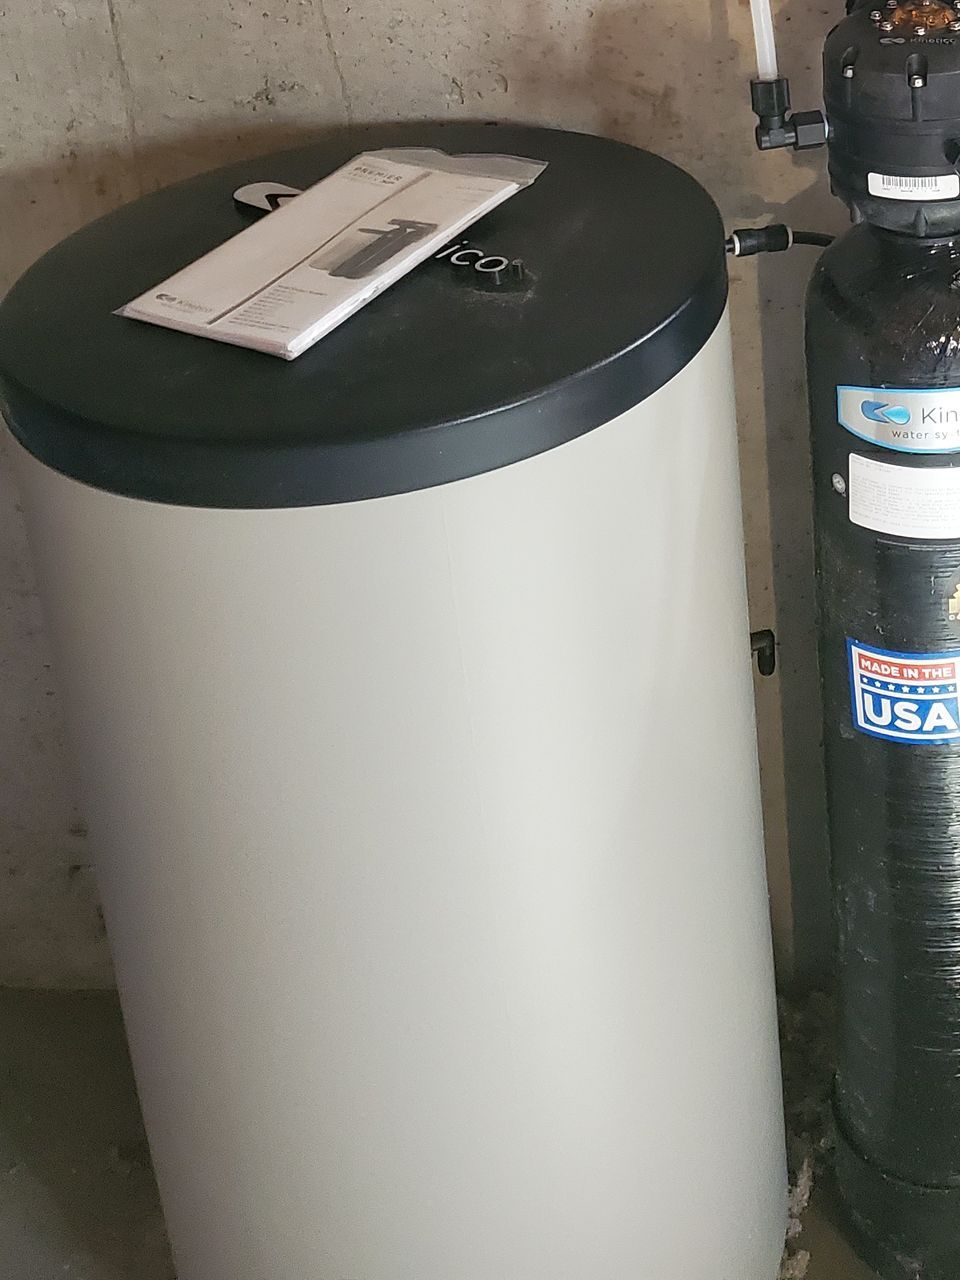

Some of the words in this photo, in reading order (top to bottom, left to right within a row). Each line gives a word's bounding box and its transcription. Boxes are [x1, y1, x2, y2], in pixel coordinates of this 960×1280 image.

[892, 431, 929, 439] water
[861, 658, 900, 677] MADE
[903, 670, 919, 680] IN
[922, 667, 952, 679] THE
[863, 692, 959, 731] USA
